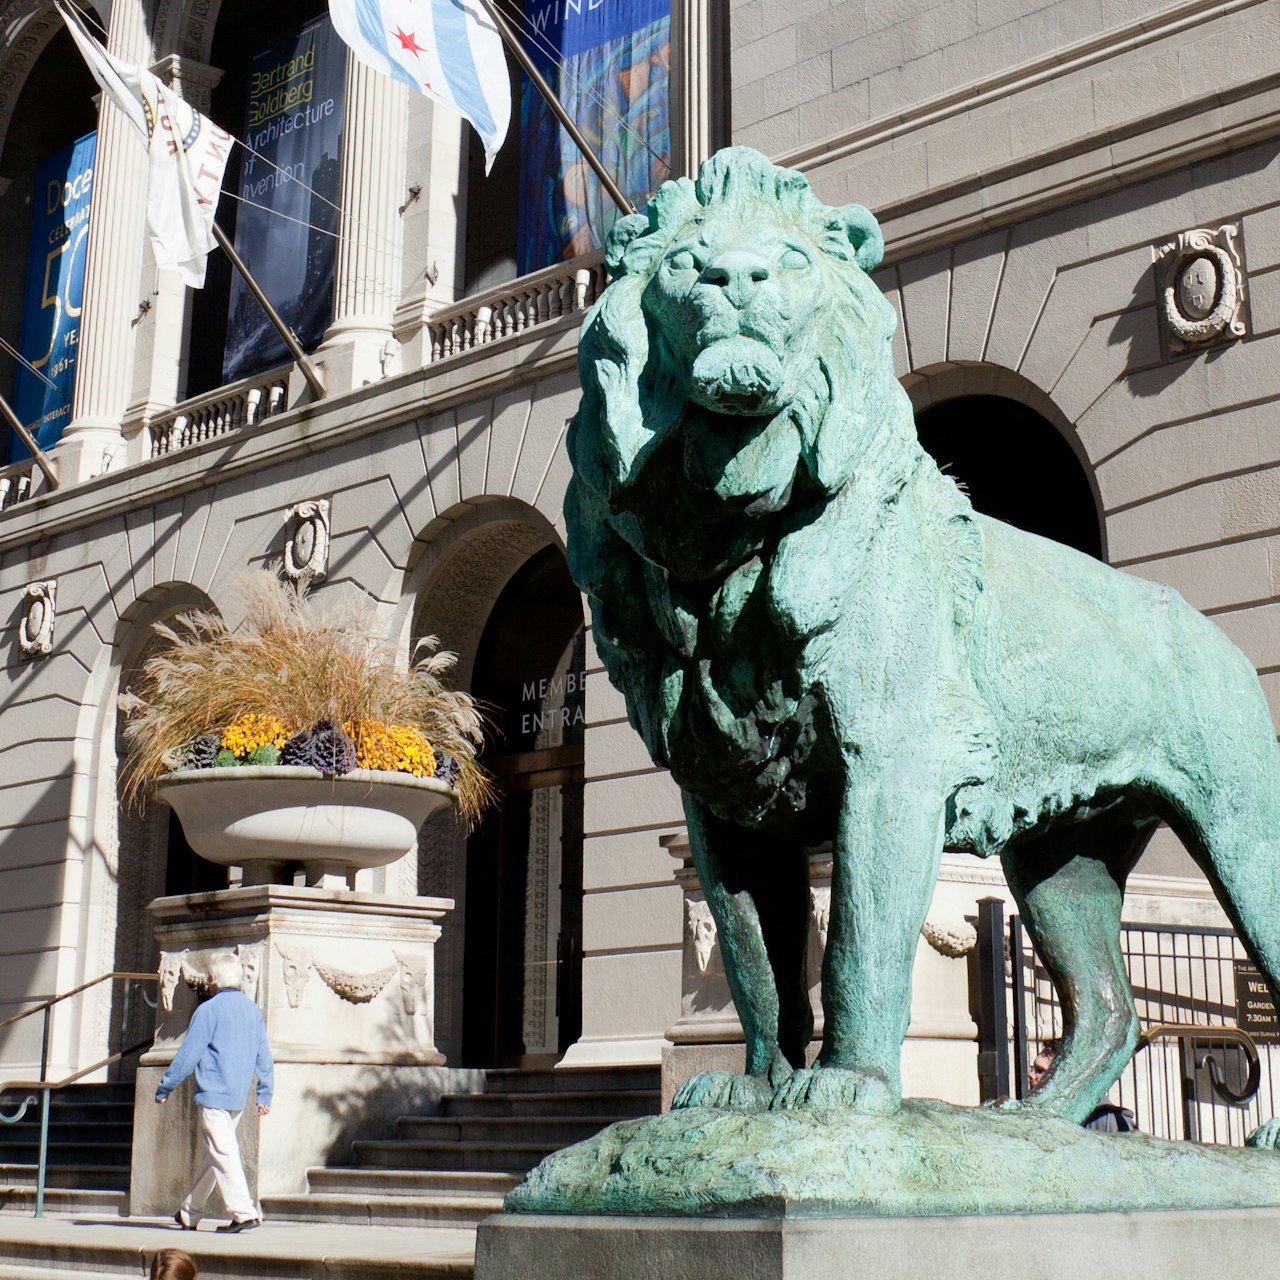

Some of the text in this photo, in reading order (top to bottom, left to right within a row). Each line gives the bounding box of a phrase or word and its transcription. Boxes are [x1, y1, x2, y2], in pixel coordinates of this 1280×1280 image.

[242, 162, 304, 203] nvention
[63, 329, 79, 348] YE
[522, 704, 585, 734] ENTRA
